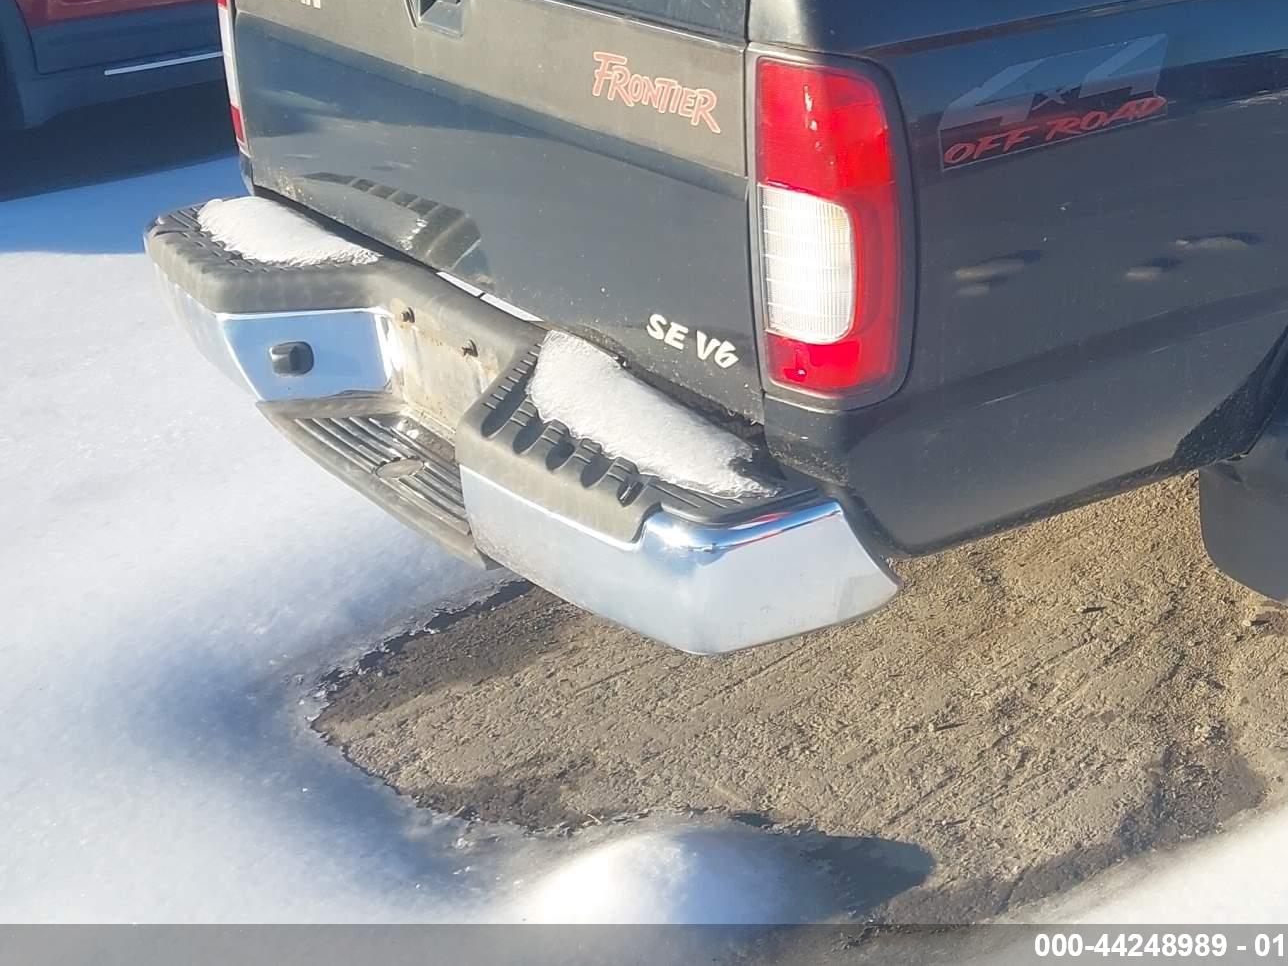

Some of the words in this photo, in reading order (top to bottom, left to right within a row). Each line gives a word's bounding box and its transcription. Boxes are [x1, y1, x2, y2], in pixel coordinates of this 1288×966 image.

[943, 125, 1039, 164] OFF
[1045, 95, 1168, 141] ROAD
[646, 313, 685, 350] SE
[694, 332, 739, 369] V6
